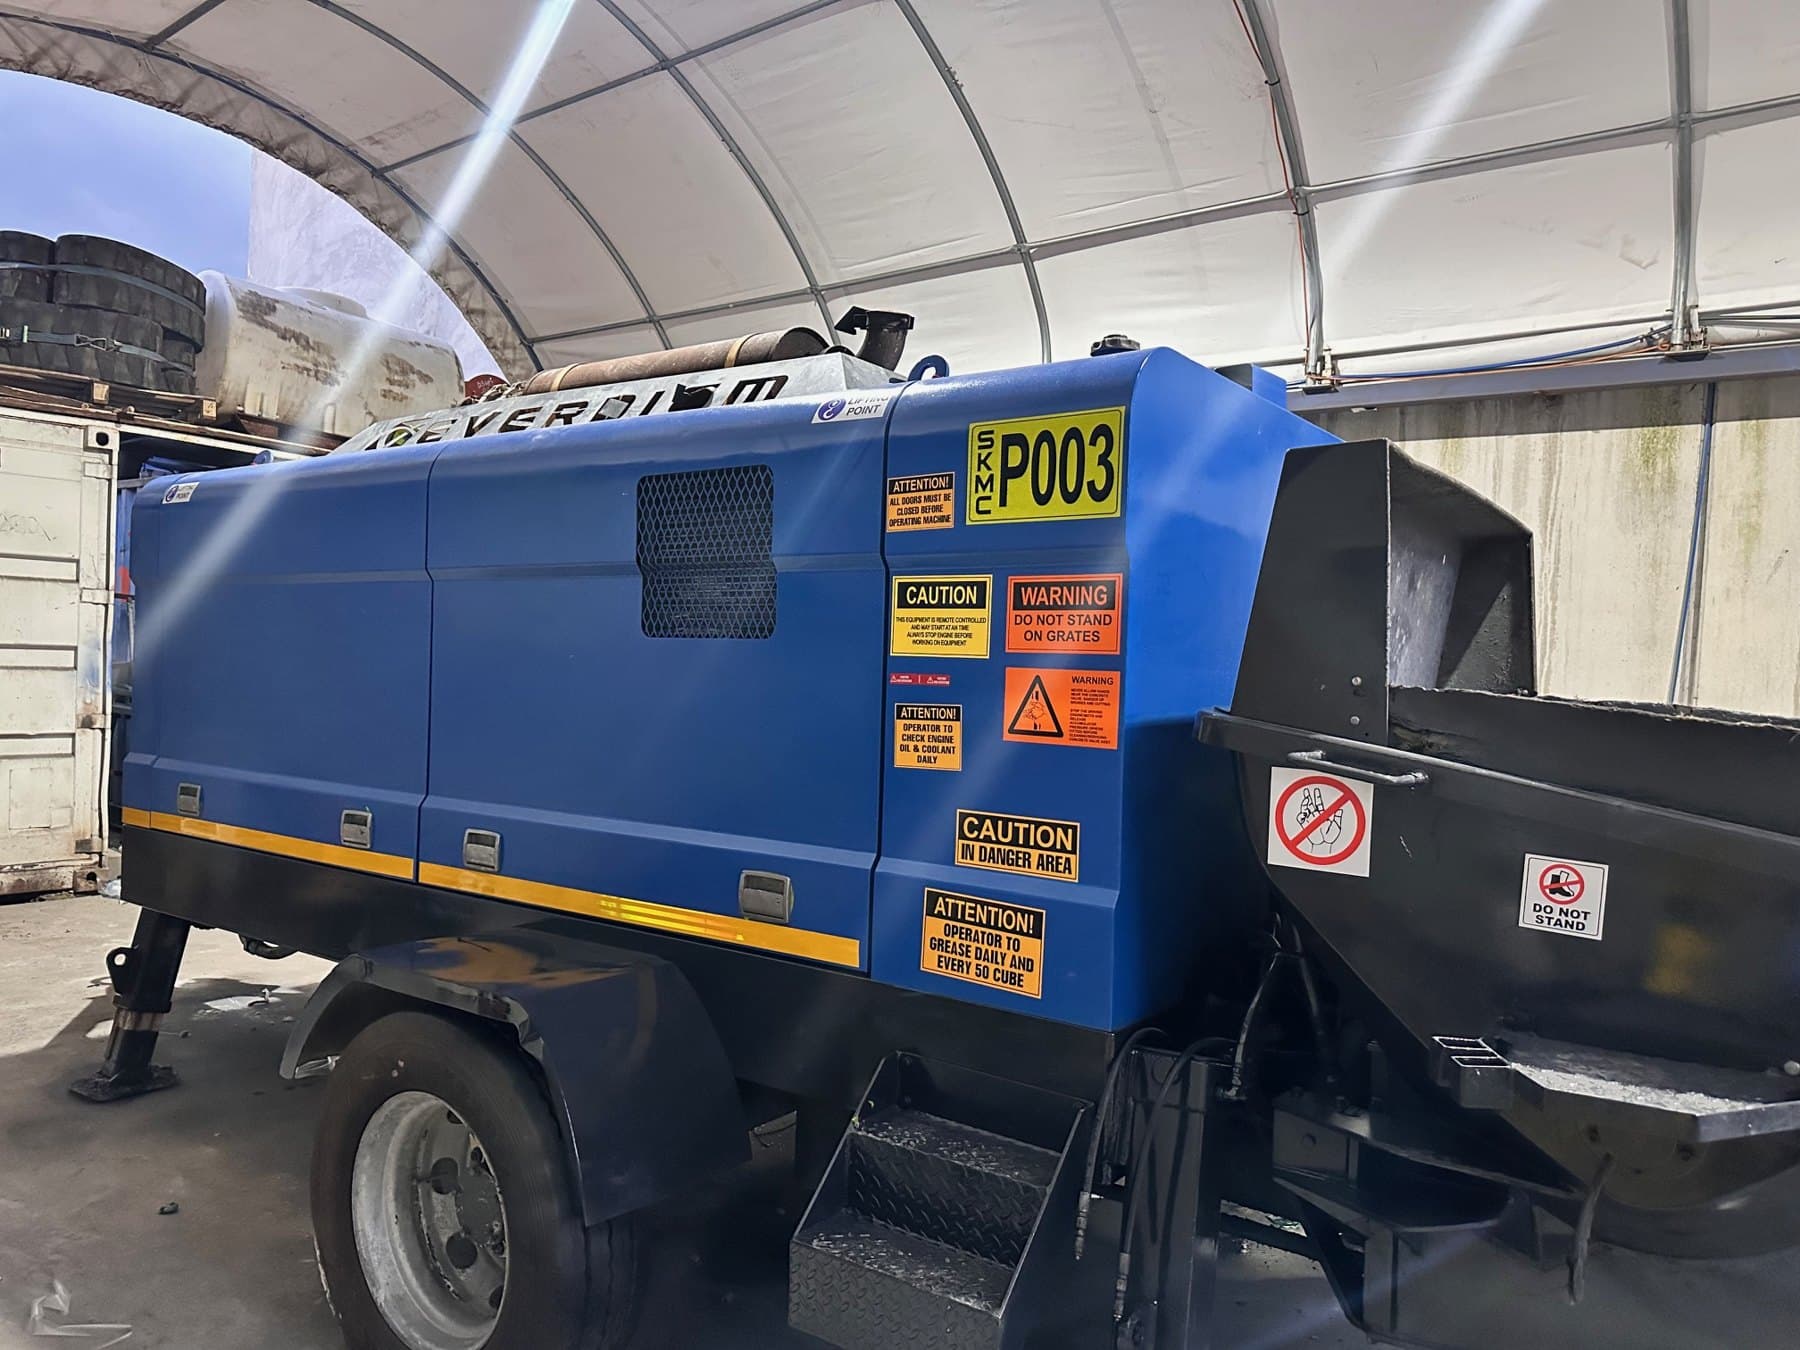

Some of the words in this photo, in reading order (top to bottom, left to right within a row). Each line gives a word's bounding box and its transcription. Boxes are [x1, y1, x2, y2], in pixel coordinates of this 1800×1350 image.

[846, 404, 881, 416] POINT
[974, 429, 995, 515] SKMC
[999, 423, 1115, 508] P003
[893, 476, 949, 493] ATTENTION!
[889, 497, 900, 506] ALL
[901, 495, 922, 505] DOORS
[923, 493, 942, 503] MUST
[943, 492, 952, 502] BE
[896, 506, 920, 516] CLOSED
[920, 503, 944, 514] BEFORE
[888, 516, 922, 527] OPERATING
[922, 514, 952, 525] MACHINE
[906, 586, 977, 605] CAUTION
[1020, 585, 1108, 606] WARNING
[1014, 614, 1033, 626] DO
[1036, 614, 1064, 626] NOT
[1067, 614, 1113, 626] STAND
[1023, 630, 1043, 642] ON
[1046, 630, 1101, 642] GRATES
[1071, 675, 1114, 686] WARNING
[900, 706, 957, 720] ATTENTION!
[903, 723, 941, 733] OPERATOR
[943, 724, 953, 734] TO
[901, 733, 926, 743] CHECK
[927, 734, 954, 744] ENGINE
[899, 744, 911, 753] OIL
[913, 744, 920, 753] &
[921, 745, 956, 755] COOLANT
[917, 754, 938, 764] DAILY
[962, 816, 1073, 851] CAUTION
[960, 843, 975, 861] IN
[978, 845, 1032, 869] DANGER
[1036, 853, 1072, 875] AREA
[933, 896, 1035, 934] ATTENTION!
[1533, 903, 1554, 915] DO
[1558, 907, 1591, 921] NOT
[1535, 914, 1586, 931] STAND
[943, 922, 1003, 948] OPERATOR
[1005, 936, 1021, 952] TO
[929, 936, 972, 958] GREASE
[974, 945, 1008, 967] DAILY
[1009, 956, 1035, 973] AND
[937, 954, 972, 976] EVERY
[974, 964, 990, 980] 50
[992, 967, 1025, 988] CUBE
